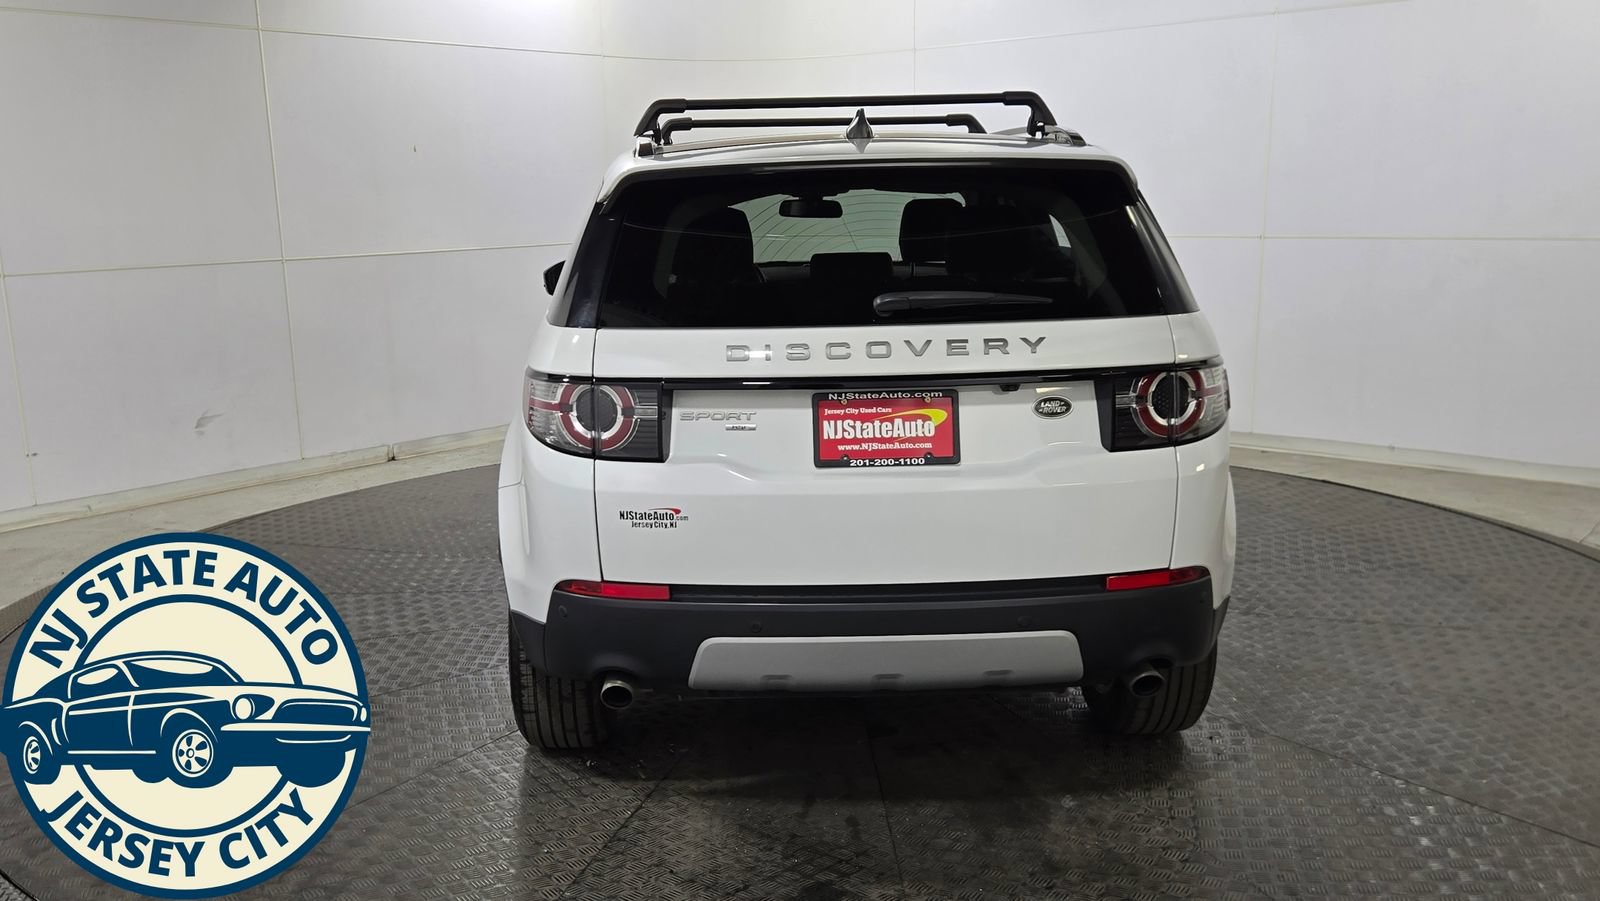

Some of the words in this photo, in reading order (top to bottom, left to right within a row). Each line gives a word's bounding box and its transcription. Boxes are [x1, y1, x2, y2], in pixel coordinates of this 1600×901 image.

[726, 336, 1047, 362] DISCOVERY
[828, 391, 943, 400] NJStateAuto.com
[680, 411, 757, 421] SPORT
[824, 408, 845, 416] Jersey
[823, 418, 936, 440] NJStateAuto
[838, 442, 932, 451] www.NJStateAuto.com
[850, 457, 925, 466] 201-200-1100
[619, 510, 689, 521] NJStateAuto.com
[631, 521, 653, 529] Jersey
